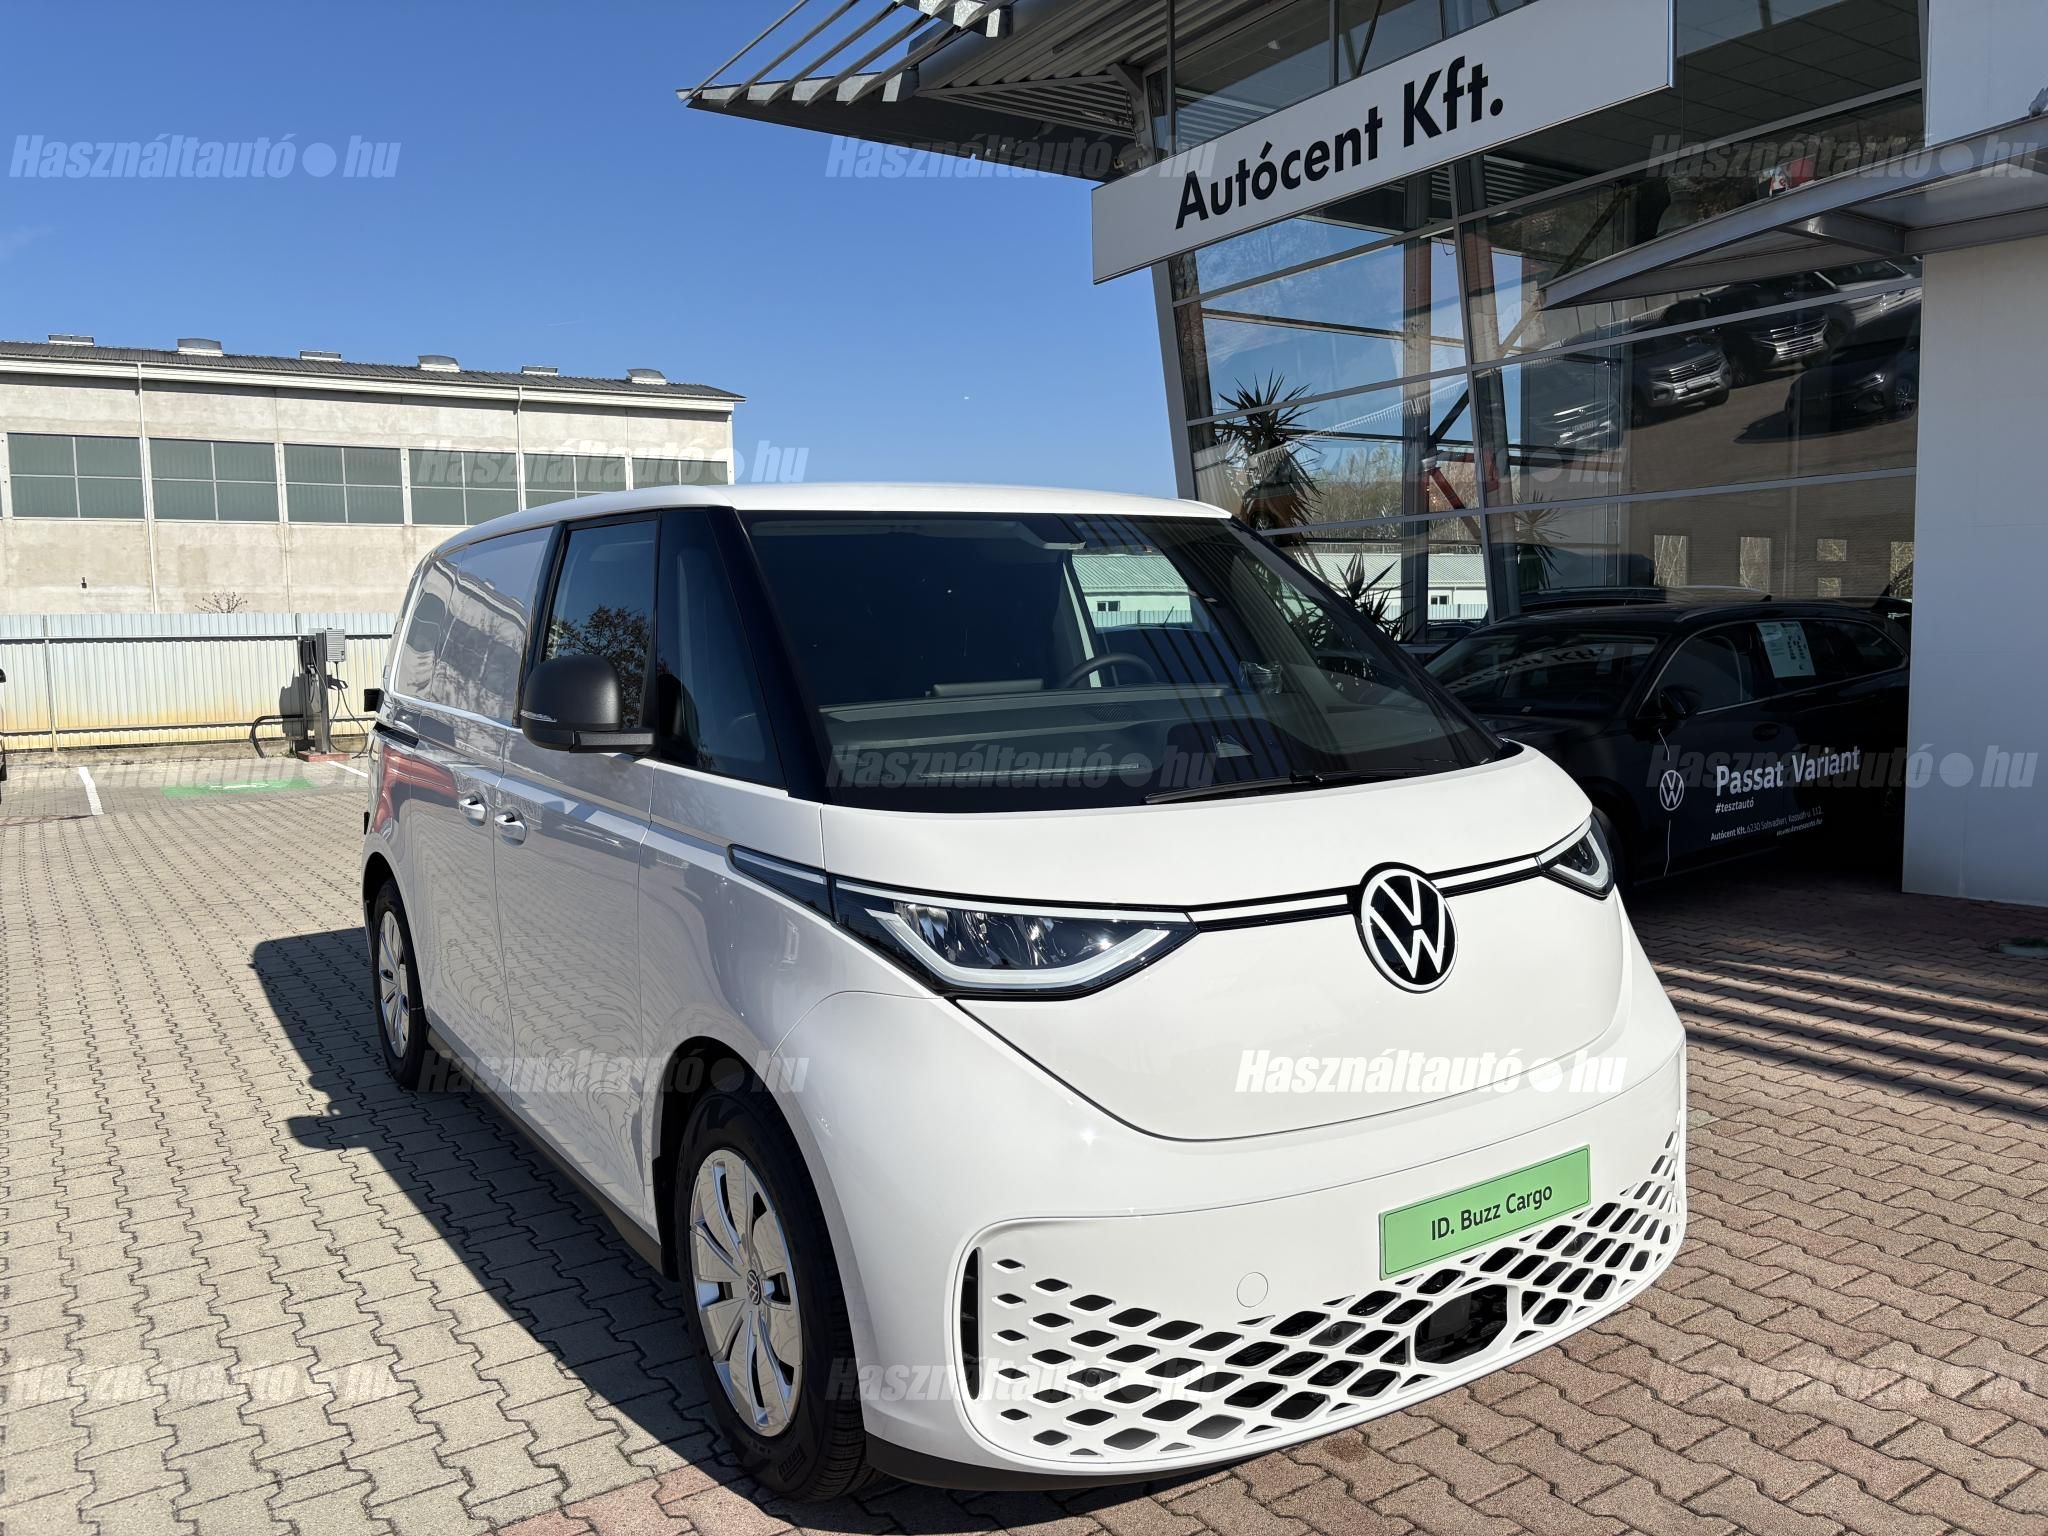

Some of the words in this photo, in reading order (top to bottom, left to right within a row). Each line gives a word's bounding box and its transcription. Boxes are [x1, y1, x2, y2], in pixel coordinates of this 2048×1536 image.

[1175, 106, 1383, 230] Autócent
[1403, 56, 1504, 147] Kft.
[1716, 761, 1784, 796] Passat
[1792, 745, 1860, 783] Variant
[1715, 797, 1755, 814] #tesztautó
[1431, 1219, 1455, 1240] ID.
[1460, 1203, 1501, 1230] Buzz
[1505, 1185, 1553, 1215] Cargo
